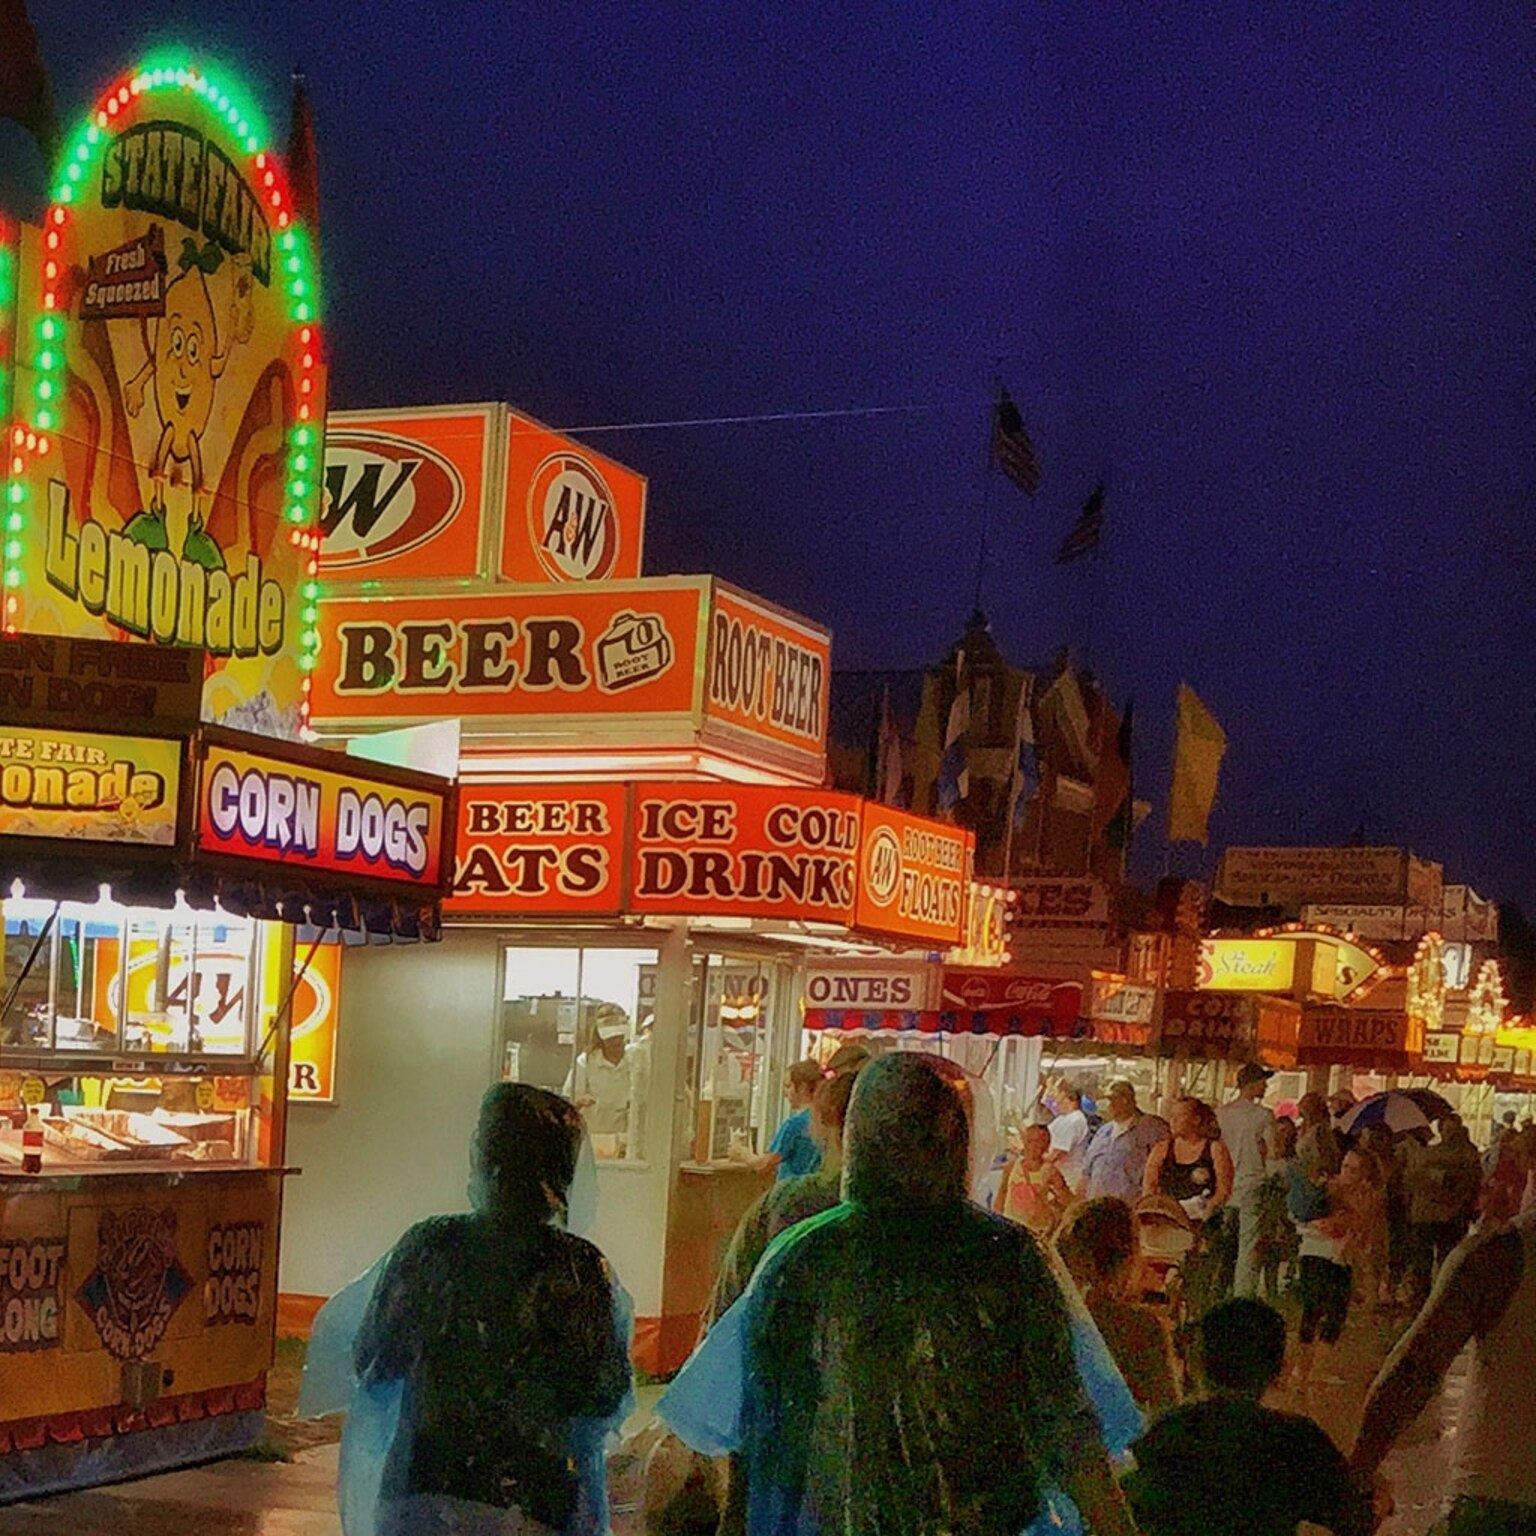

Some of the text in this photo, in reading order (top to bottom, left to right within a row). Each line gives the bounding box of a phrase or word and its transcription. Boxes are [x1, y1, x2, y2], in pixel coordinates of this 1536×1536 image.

[104, 123, 202, 227] STATE
[104, 242, 146, 276] Fresh
[84, 273, 160, 310] Squeezed
[46, 480, 285, 656] Lemonade
[339, 619, 588, 694] BEER
[711, 610, 823, 742] ROOT BEER
[39, 739, 108, 766] FAIR
[209, 762, 430, 875] CORN DOGS
[468, 801, 609, 834] BEER
[640, 802, 856, 852] ICE COLD
[903, 828, 934, 864] ROOT
[934, 836, 962, 871] BEER
[638, 849, 854, 907] DRINKS
[899, 870, 960, 925] FLOATS
[208, 1227, 263, 1273] CORN
[204, 1271, 260, 1319] DOGS
